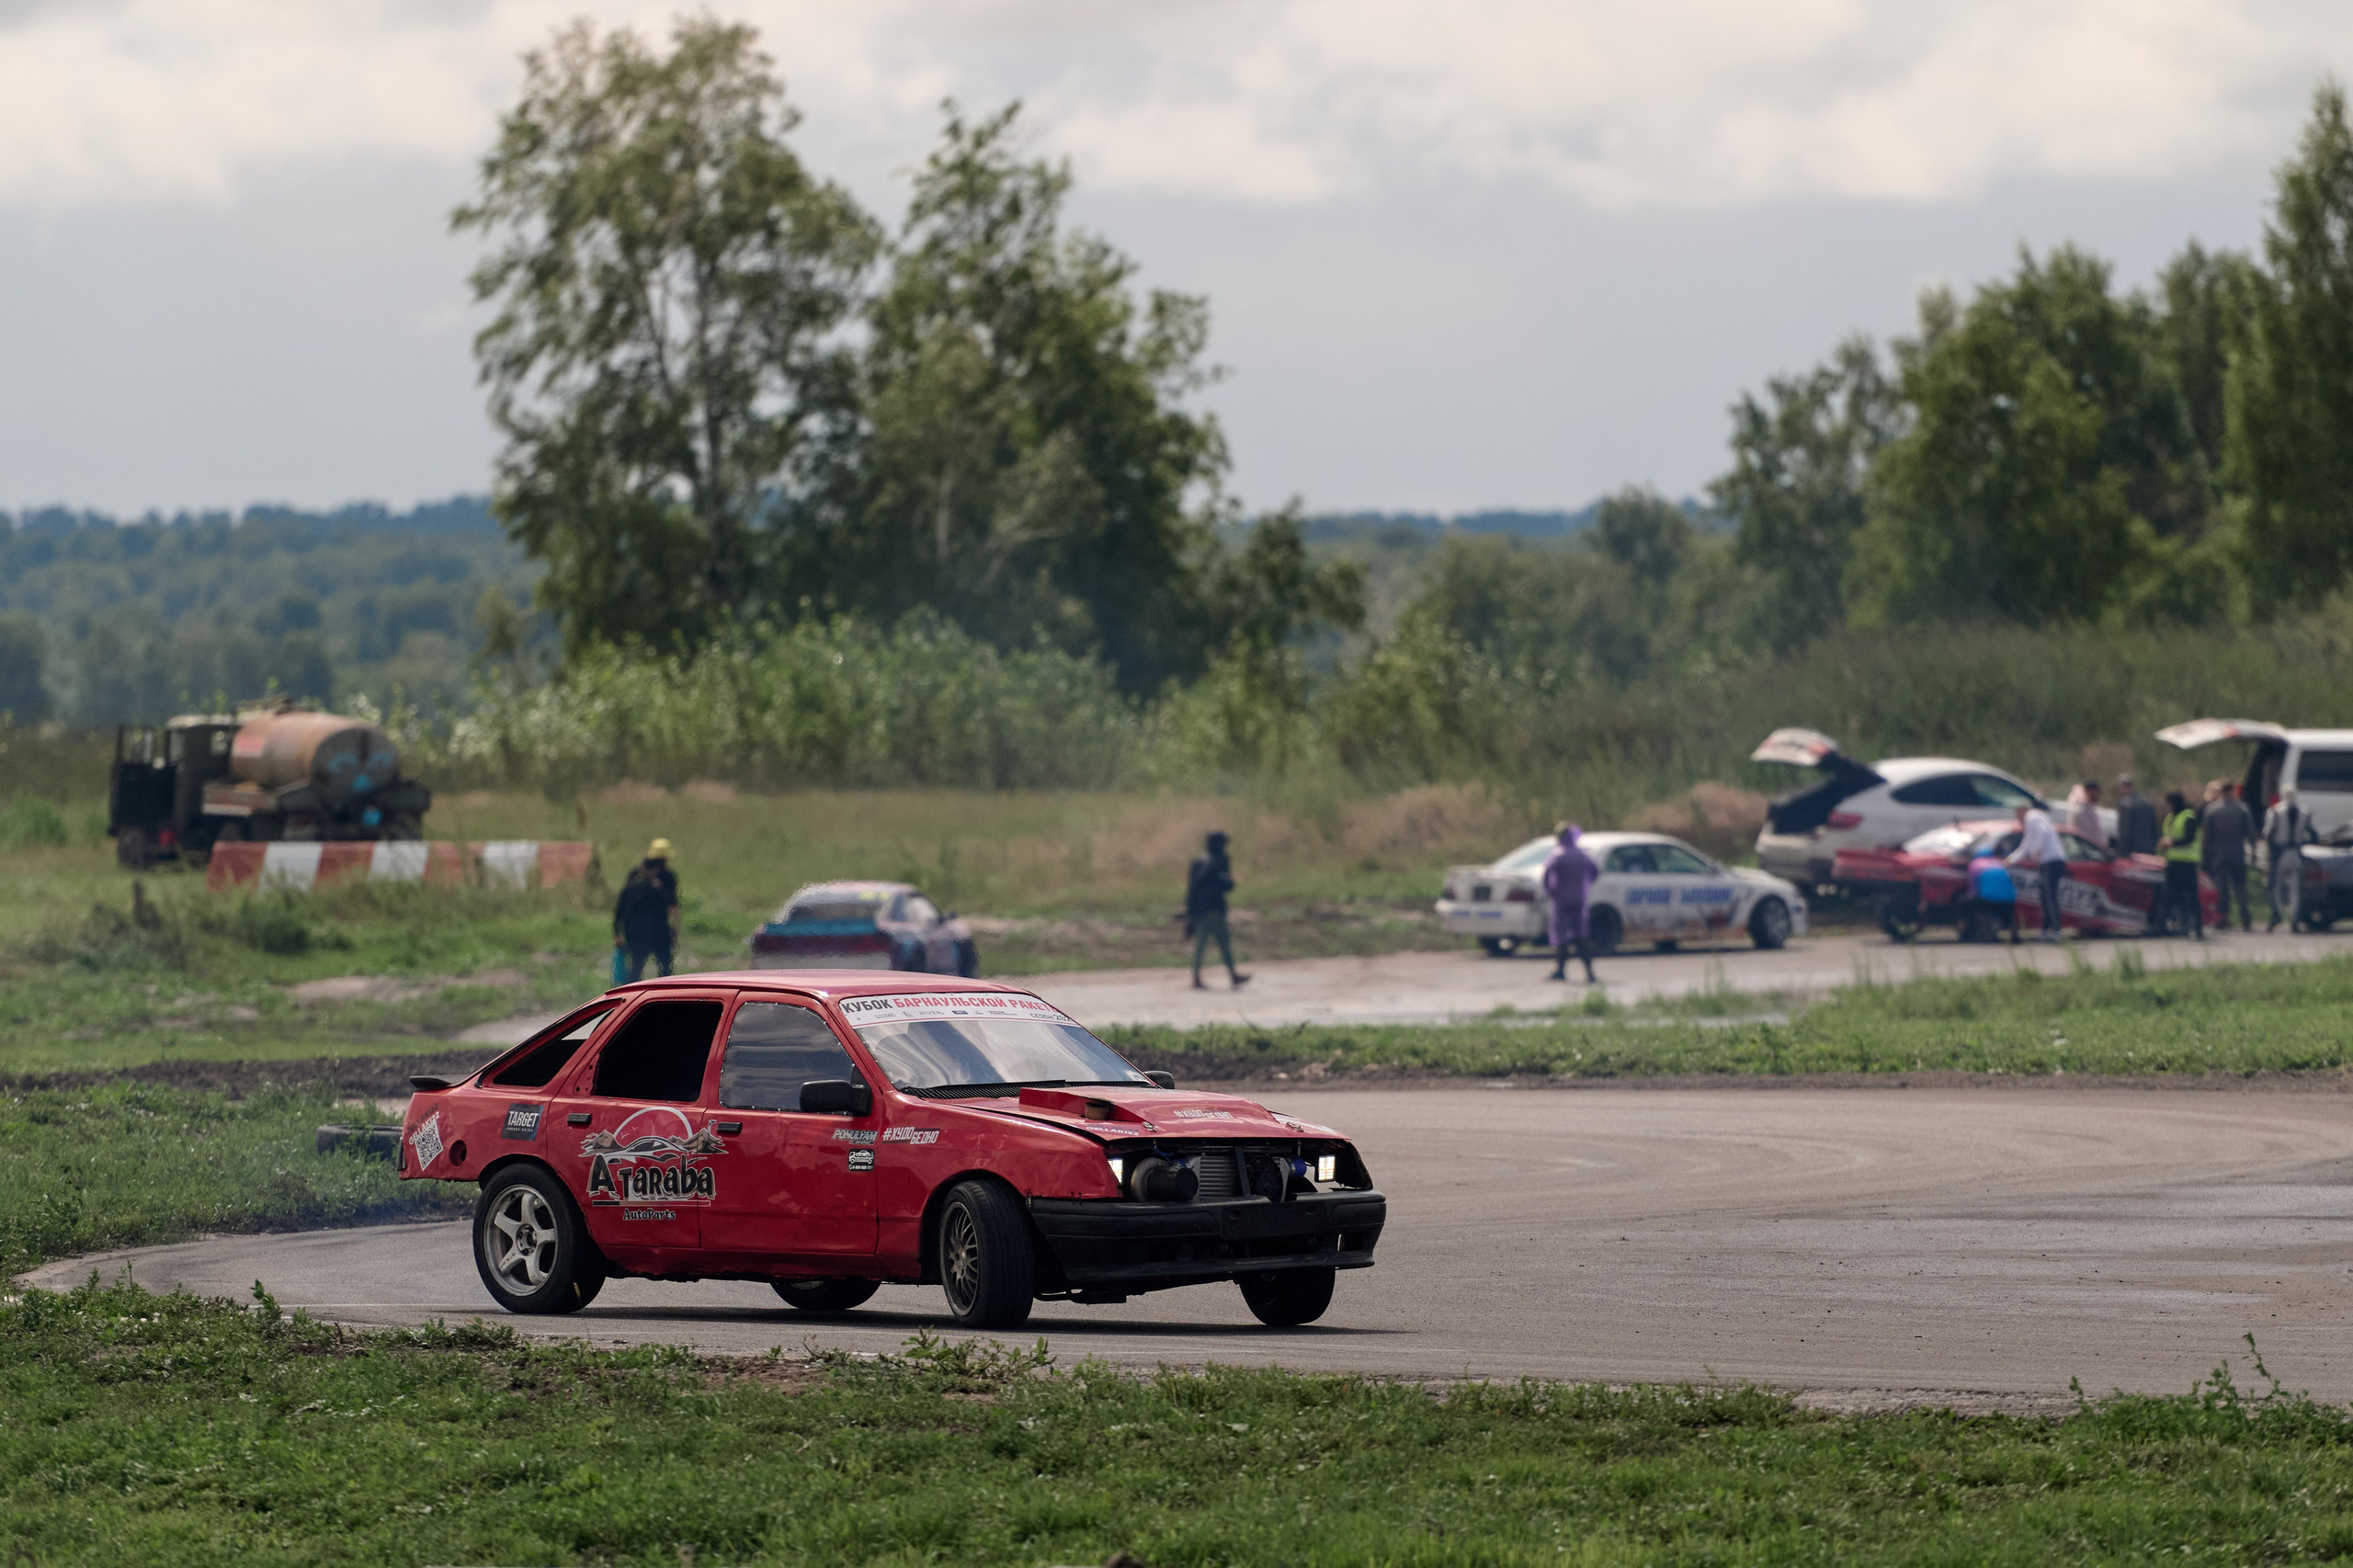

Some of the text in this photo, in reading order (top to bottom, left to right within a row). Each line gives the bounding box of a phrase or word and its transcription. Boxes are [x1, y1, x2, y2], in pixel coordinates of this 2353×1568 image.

[842, 999, 893, 1013] КУБОК
[892, 996, 1007, 1009] БАРНАУЛЬСКОЙ
[507, 1110, 540, 1128] TARGET
[1086, 1126, 1140, 1136] GELLAKI22
[623, 1209, 676, 1220] AutoParts
